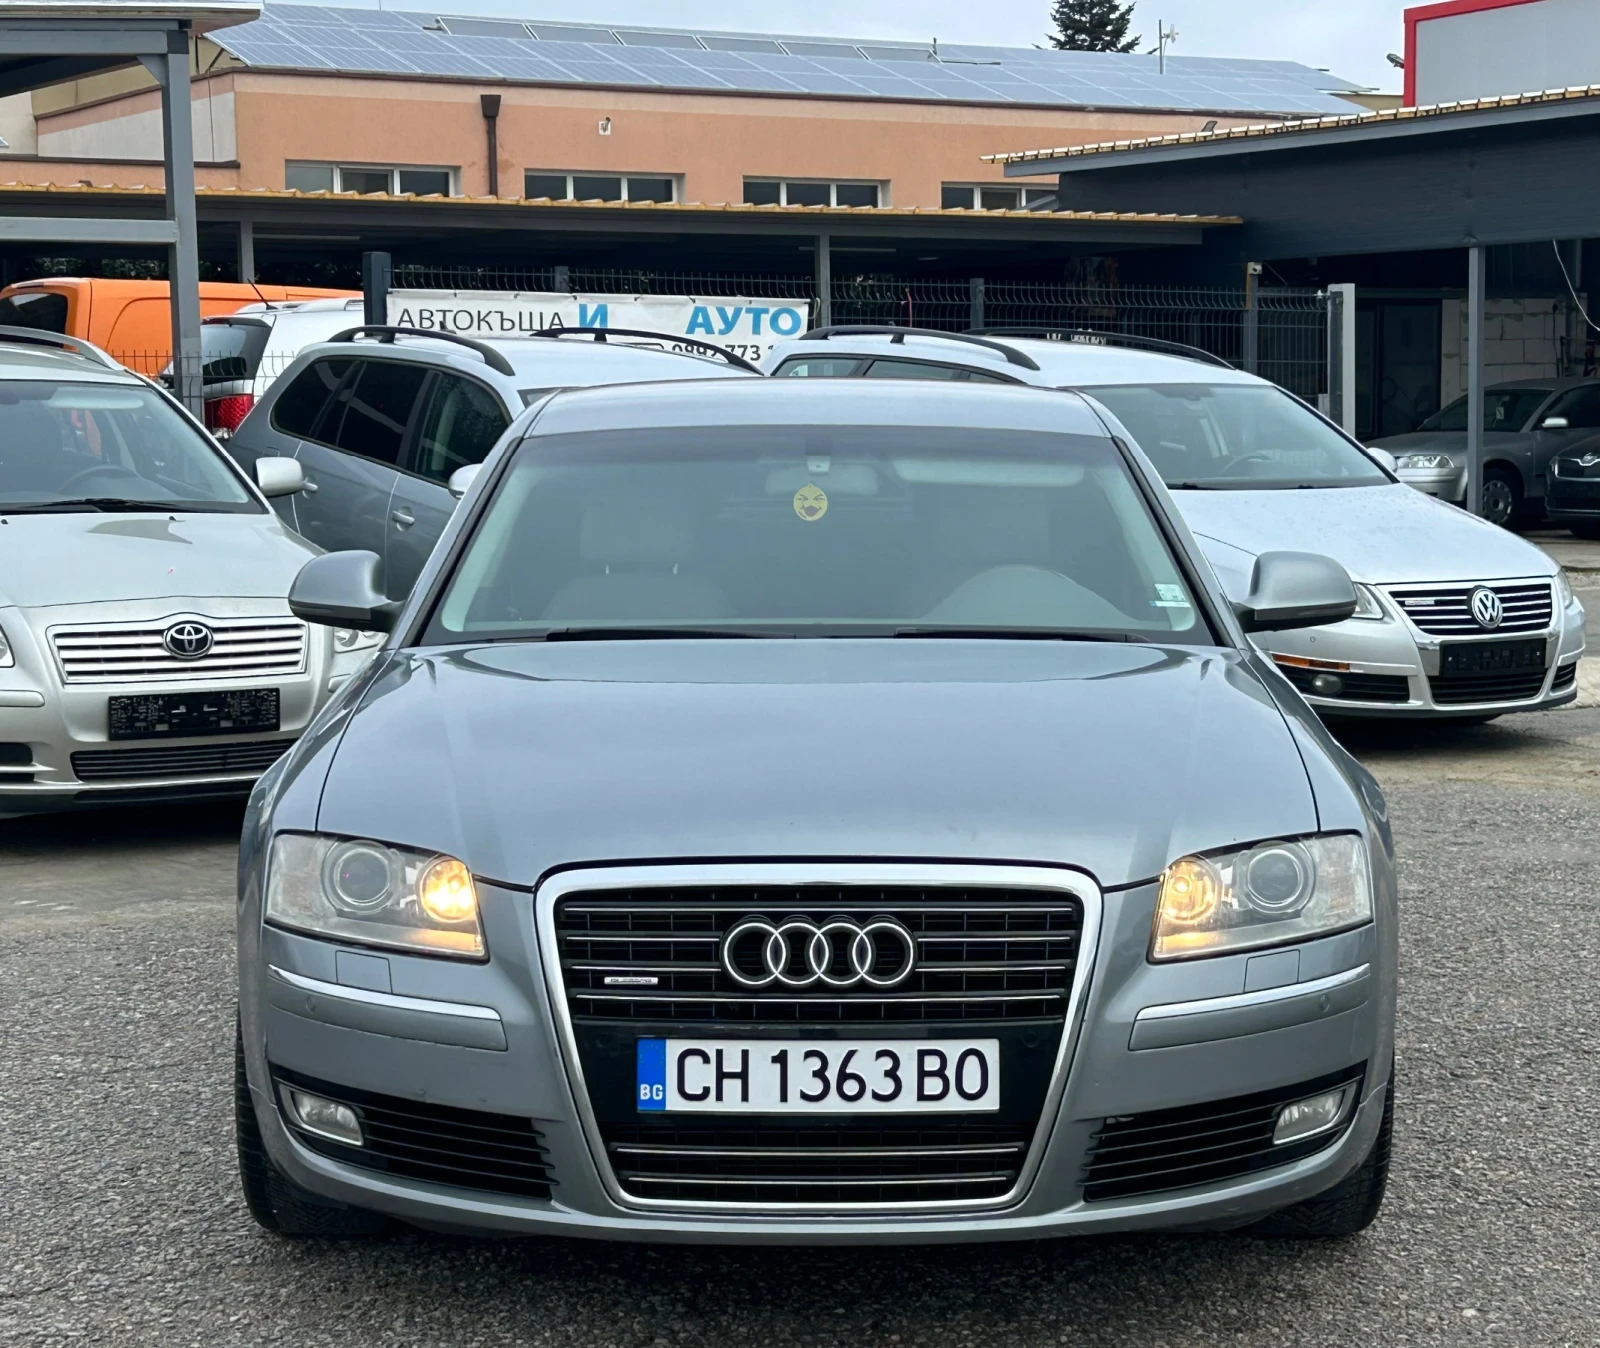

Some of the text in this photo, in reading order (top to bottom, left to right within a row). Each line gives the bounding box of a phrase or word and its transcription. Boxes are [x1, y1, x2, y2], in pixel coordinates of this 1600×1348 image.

[578, 303, 608, 328] И
[685, 306, 802, 336] АУТО
[770, 1048, 902, 1103] 1363
[640, 1084, 663, 1101] BG
